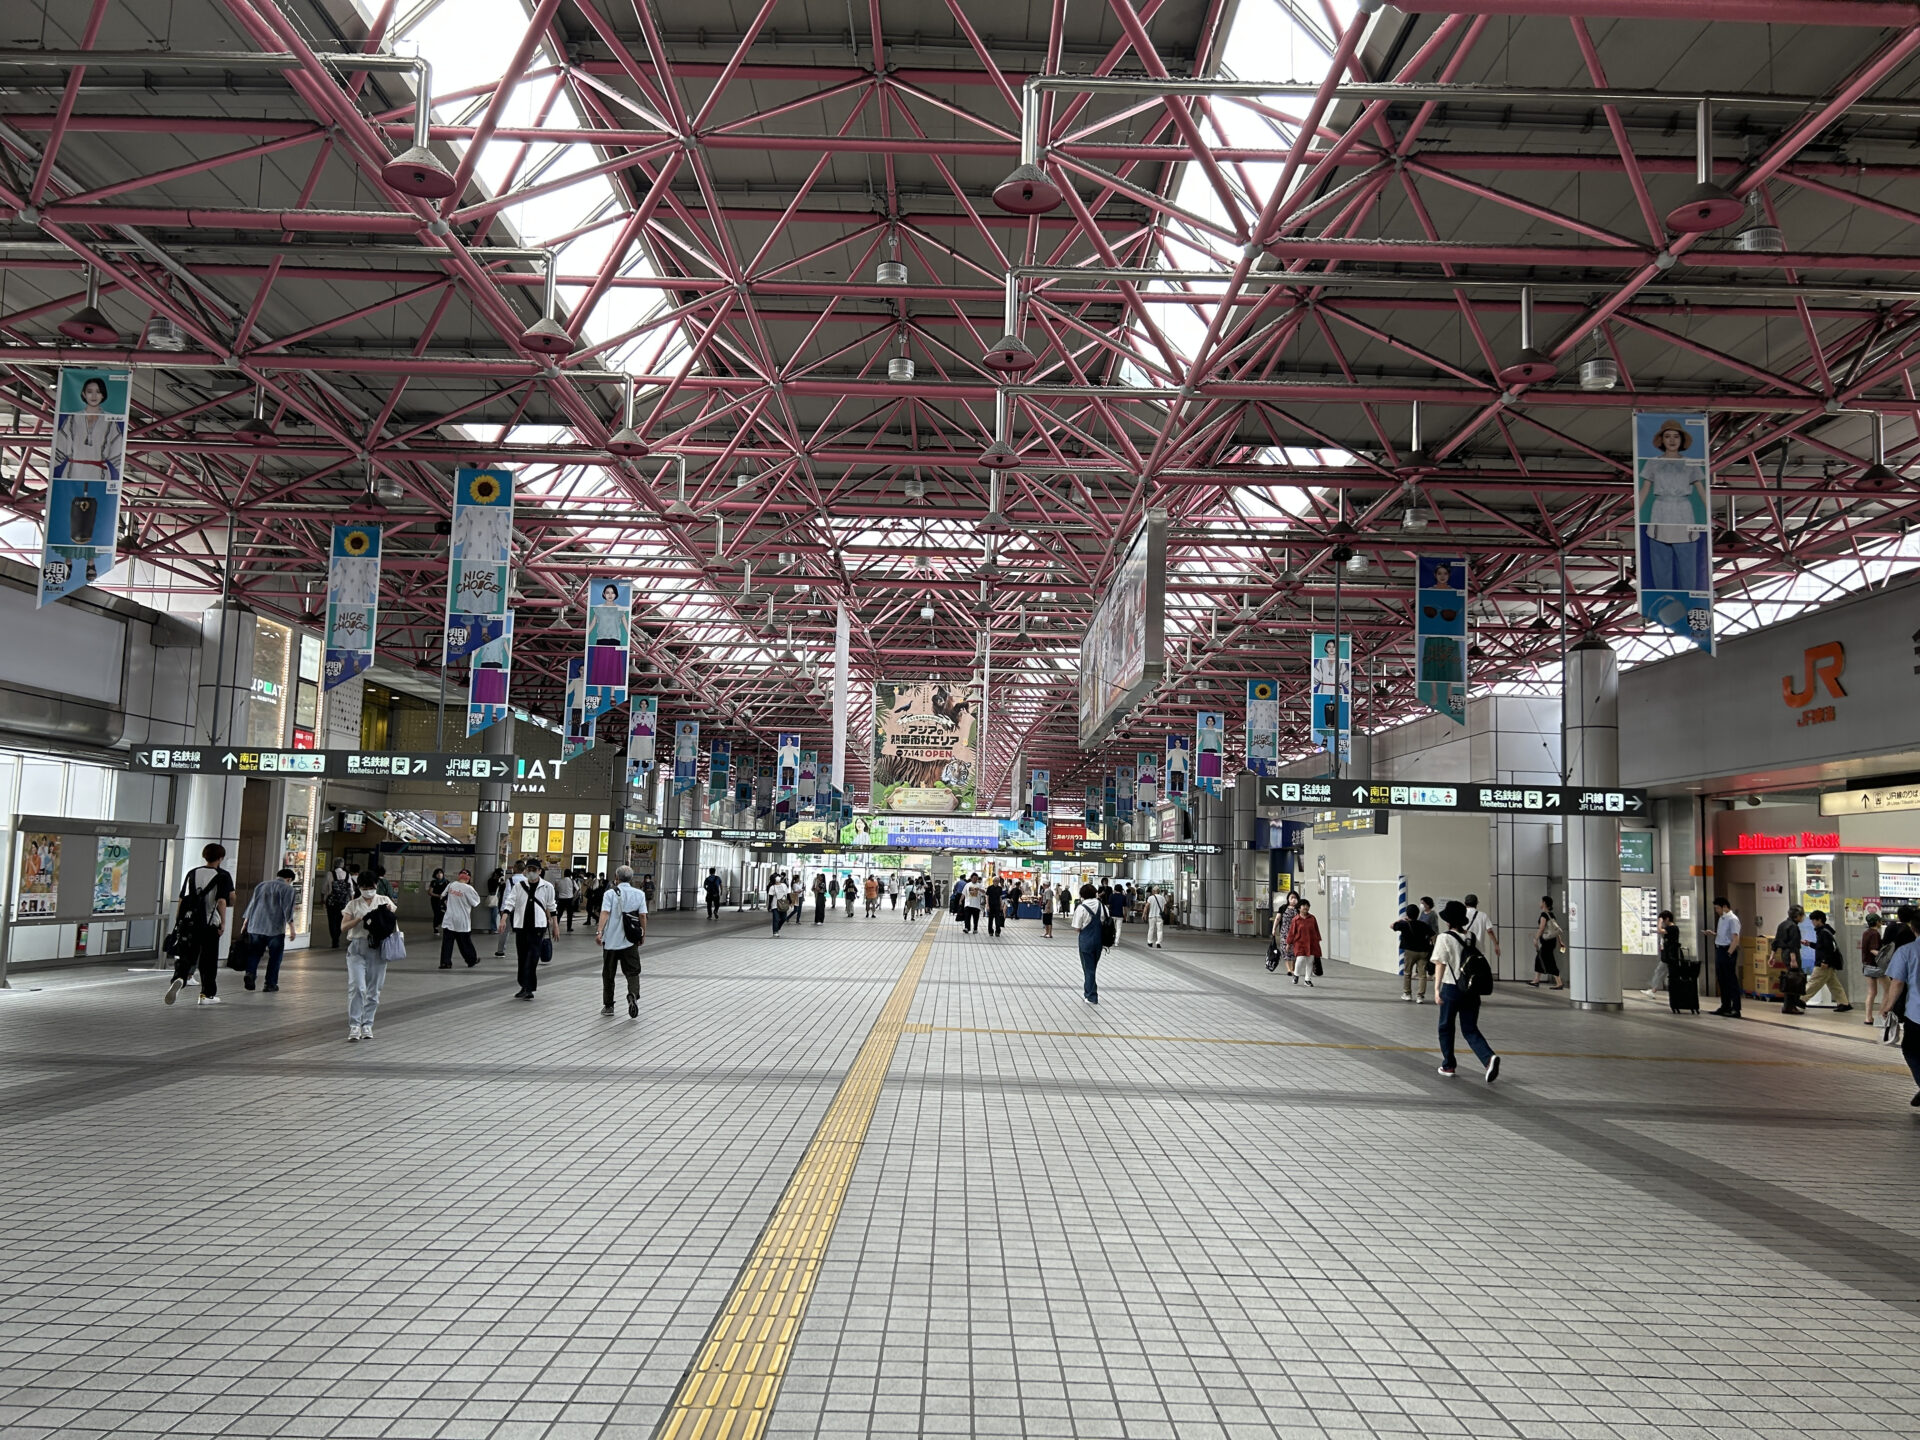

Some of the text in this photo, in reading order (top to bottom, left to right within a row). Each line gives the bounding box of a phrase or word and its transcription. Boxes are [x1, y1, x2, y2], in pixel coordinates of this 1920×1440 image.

[464, 570, 495, 581] NICE
[338, 612, 366, 621] NICE
[1782, 641, 1848, 708] JR
[908, 725, 944, 735] アジアの
[171, 750, 201, 763] 名鉄線
[239, 753, 259, 764] 南口
[925, 750, 952, 758] OPEN
[361, 756, 390, 768] 名鉄線
[446, 758, 471, 770] JR線
[347, 767, 374, 775] Meitetsu
[1302, 783, 1331, 795] 名鉄線
[1370, 786, 1389, 797] 南口
[1493, 790, 1522, 801] 名鉄線
[1579, 792, 1604, 804] JR線
[1480, 800, 1507, 808] Meitetsu
[1738, 832, 1841, 849] Bellmart Kiosk
[107, 845, 121, 858] 70
